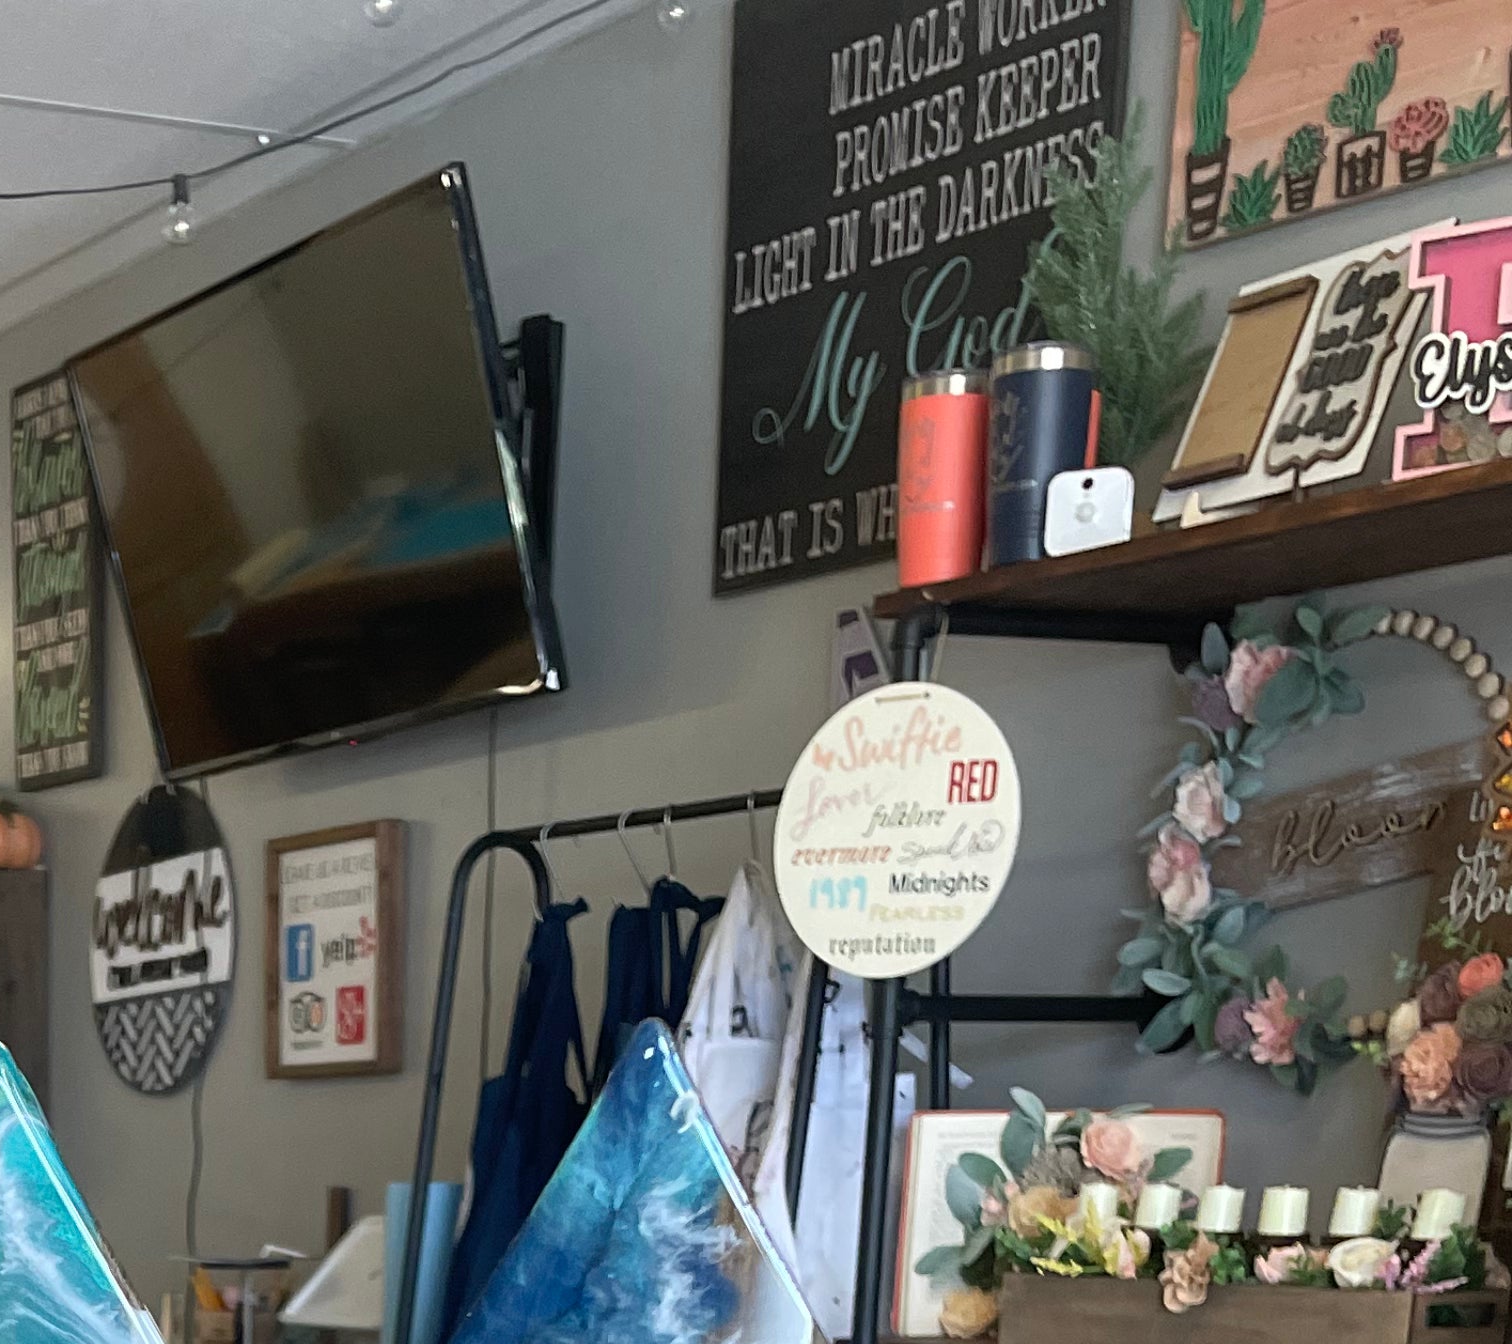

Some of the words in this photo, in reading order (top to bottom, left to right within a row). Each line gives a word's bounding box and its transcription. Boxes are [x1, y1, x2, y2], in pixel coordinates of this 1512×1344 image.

[829, 0, 965, 115] MIRACLE
[977, 0, 1106, 55] WOR
[833, 85, 965, 197] PROMISE
[973, 32, 1102, 143] KEEPER
[733, 226, 816, 314] LIGHT
[825, 209, 861, 281] IN
[870, 185, 927, 266] THE
[752, 291, 886, 475] My
[720, 510, 798, 580] THAT
[806, 498, 843, 559] IS
[856, 483, 899, 546] WH
[837, 705, 963, 772] Swiftie
[947, 758, 1000, 805] RED
[790, 845, 891, 866] evermore
[889, 871, 991, 898] Midnights
[809, 873, 868, 913] 1989
[829, 930, 937, 962] reputation
